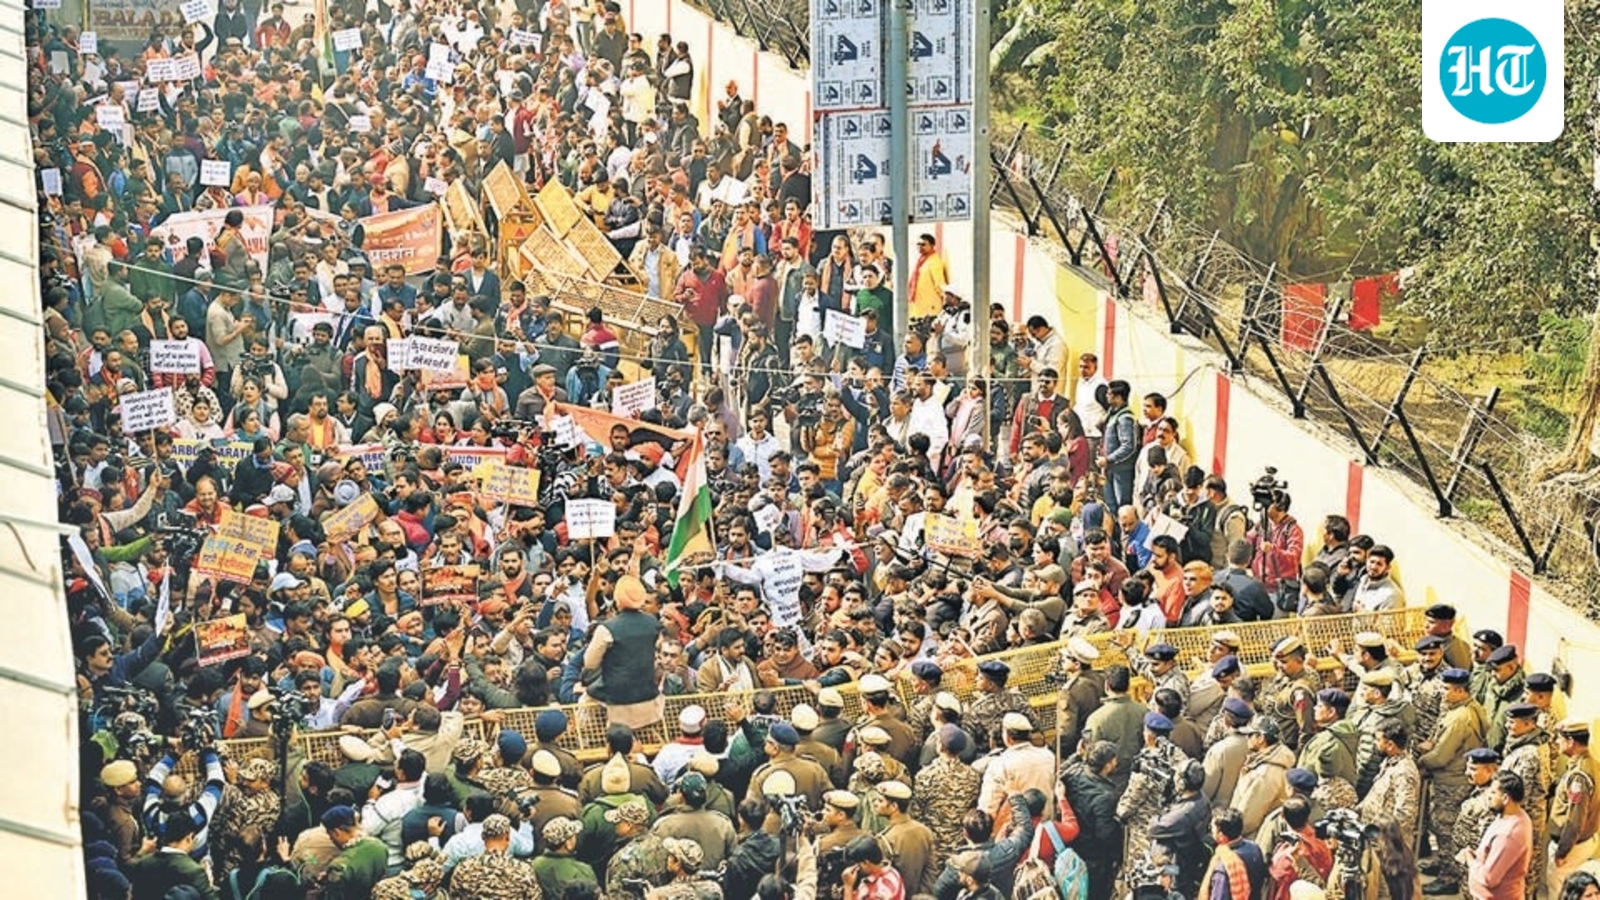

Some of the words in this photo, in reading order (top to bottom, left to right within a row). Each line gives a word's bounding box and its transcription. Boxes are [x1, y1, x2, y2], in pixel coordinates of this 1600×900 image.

[834, 34, 857, 60] 4
[910, 31, 932, 57] 4
[826, 85, 838, 102] 4
[860, 83, 872, 100] 4
[935, 80, 947, 96] 4
[844, 119, 857, 135] 4
[920, 115, 933, 131] 4
[953, 113, 966, 130] 4
[854, 154, 877, 178] 4
[928, 150, 952, 175] 4
[845, 203, 858, 219] 4
[920, 199, 933, 214] 4
[953, 197, 966, 213] 4
[171, 443, 199, 455] ARBO
